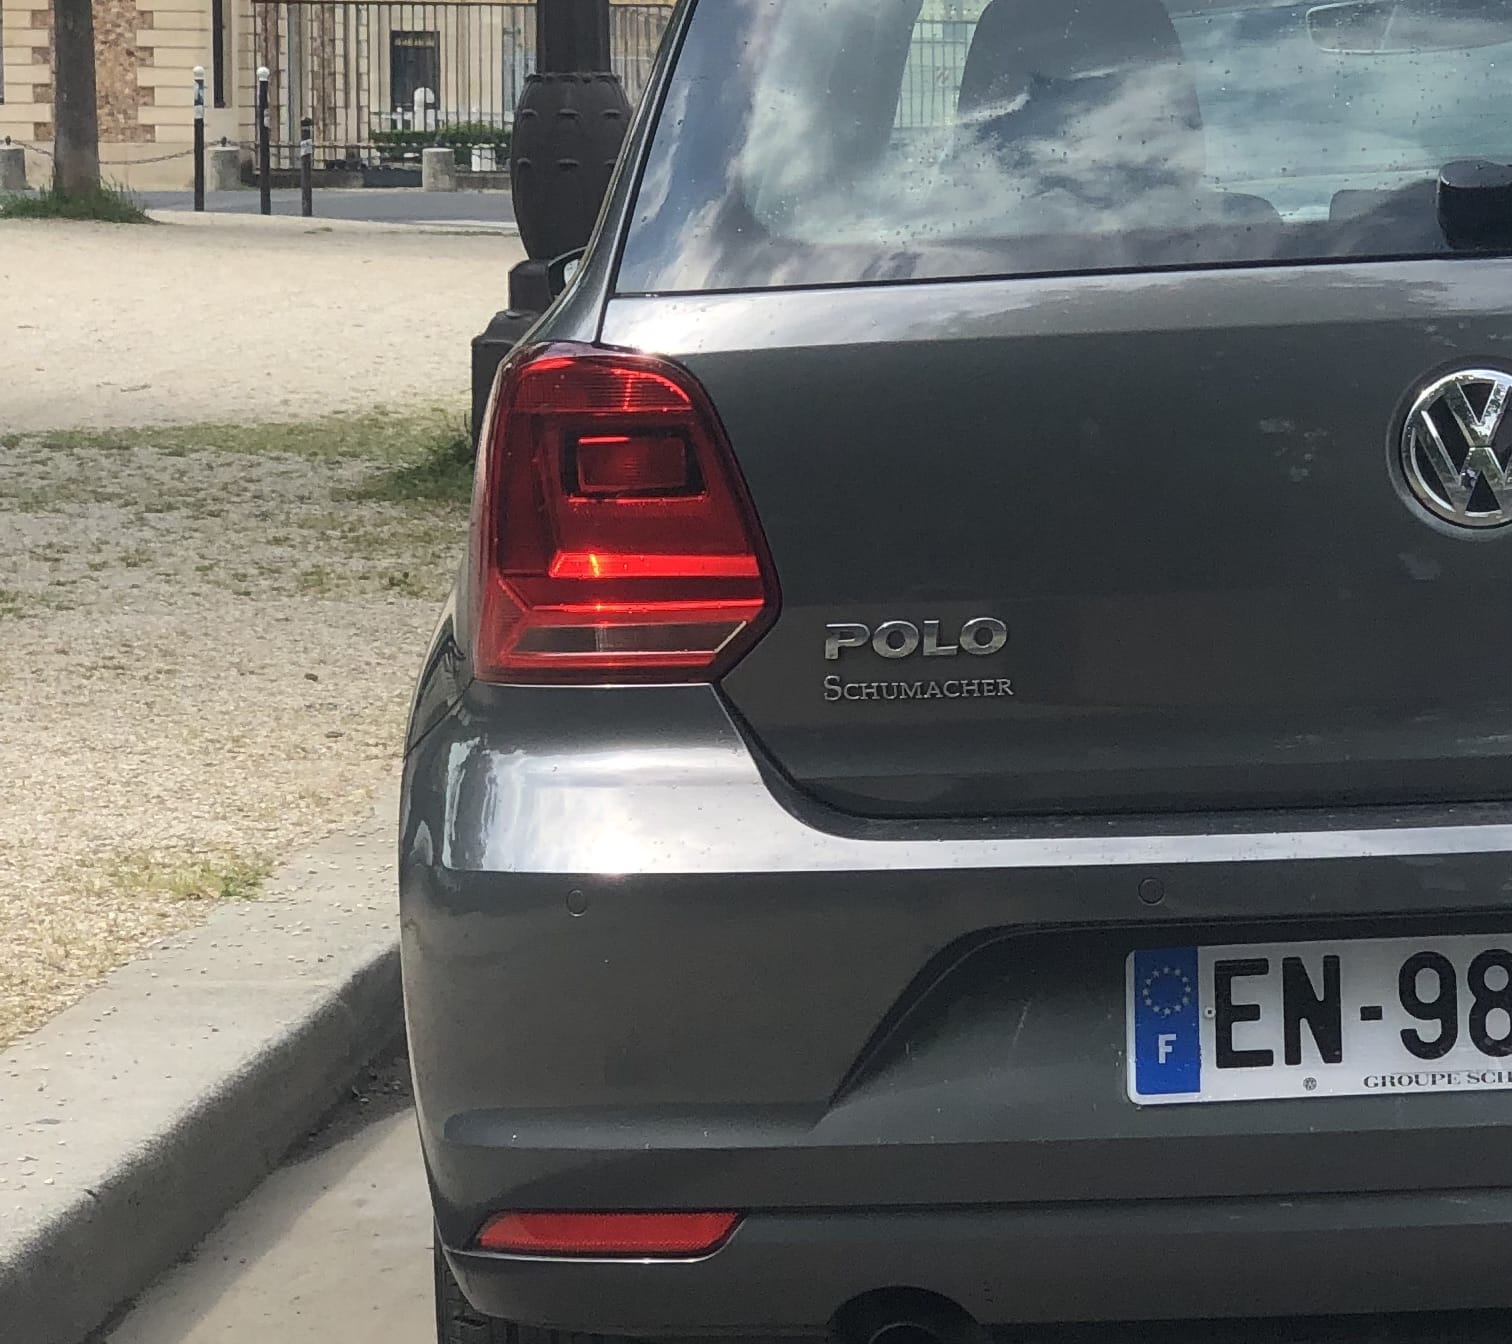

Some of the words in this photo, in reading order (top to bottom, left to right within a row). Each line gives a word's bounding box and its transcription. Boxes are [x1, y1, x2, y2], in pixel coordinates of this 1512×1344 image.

[824, 617, 1008, 660] POLO
[823, 674, 1014, 701] SCHUMACHER
[1157, 1033, 1177, 1064] F
[1363, 1071, 1461, 1088] GROUPE
